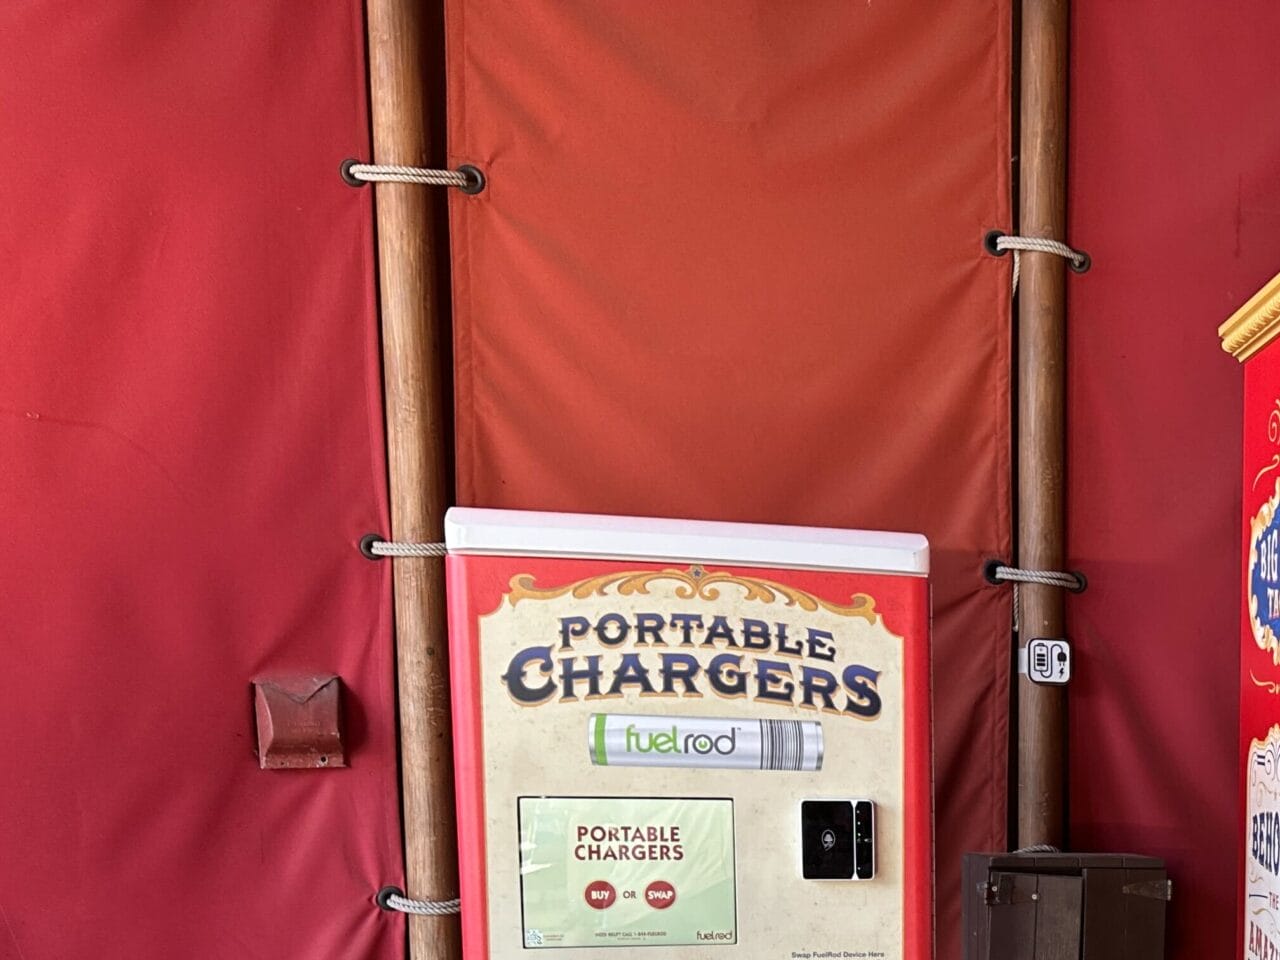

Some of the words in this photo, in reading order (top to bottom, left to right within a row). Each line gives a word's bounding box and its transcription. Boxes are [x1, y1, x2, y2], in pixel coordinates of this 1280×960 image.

[1260, 528, 1278, 583] BIG
[558, 612, 836, 662] PORTABLE
[501, 644, 882, 721] CHARGERS
[577, 825, 681, 842] PORTABLE
[574, 844, 684, 860] CHARGERS
[591, 890, 610, 900] BUY
[622, 890, 637, 899] OR
[647, 890, 674, 900] SWAP
[1267, 891, 1279, 911] THE
[696, 930, 733, 941] fuelrod
